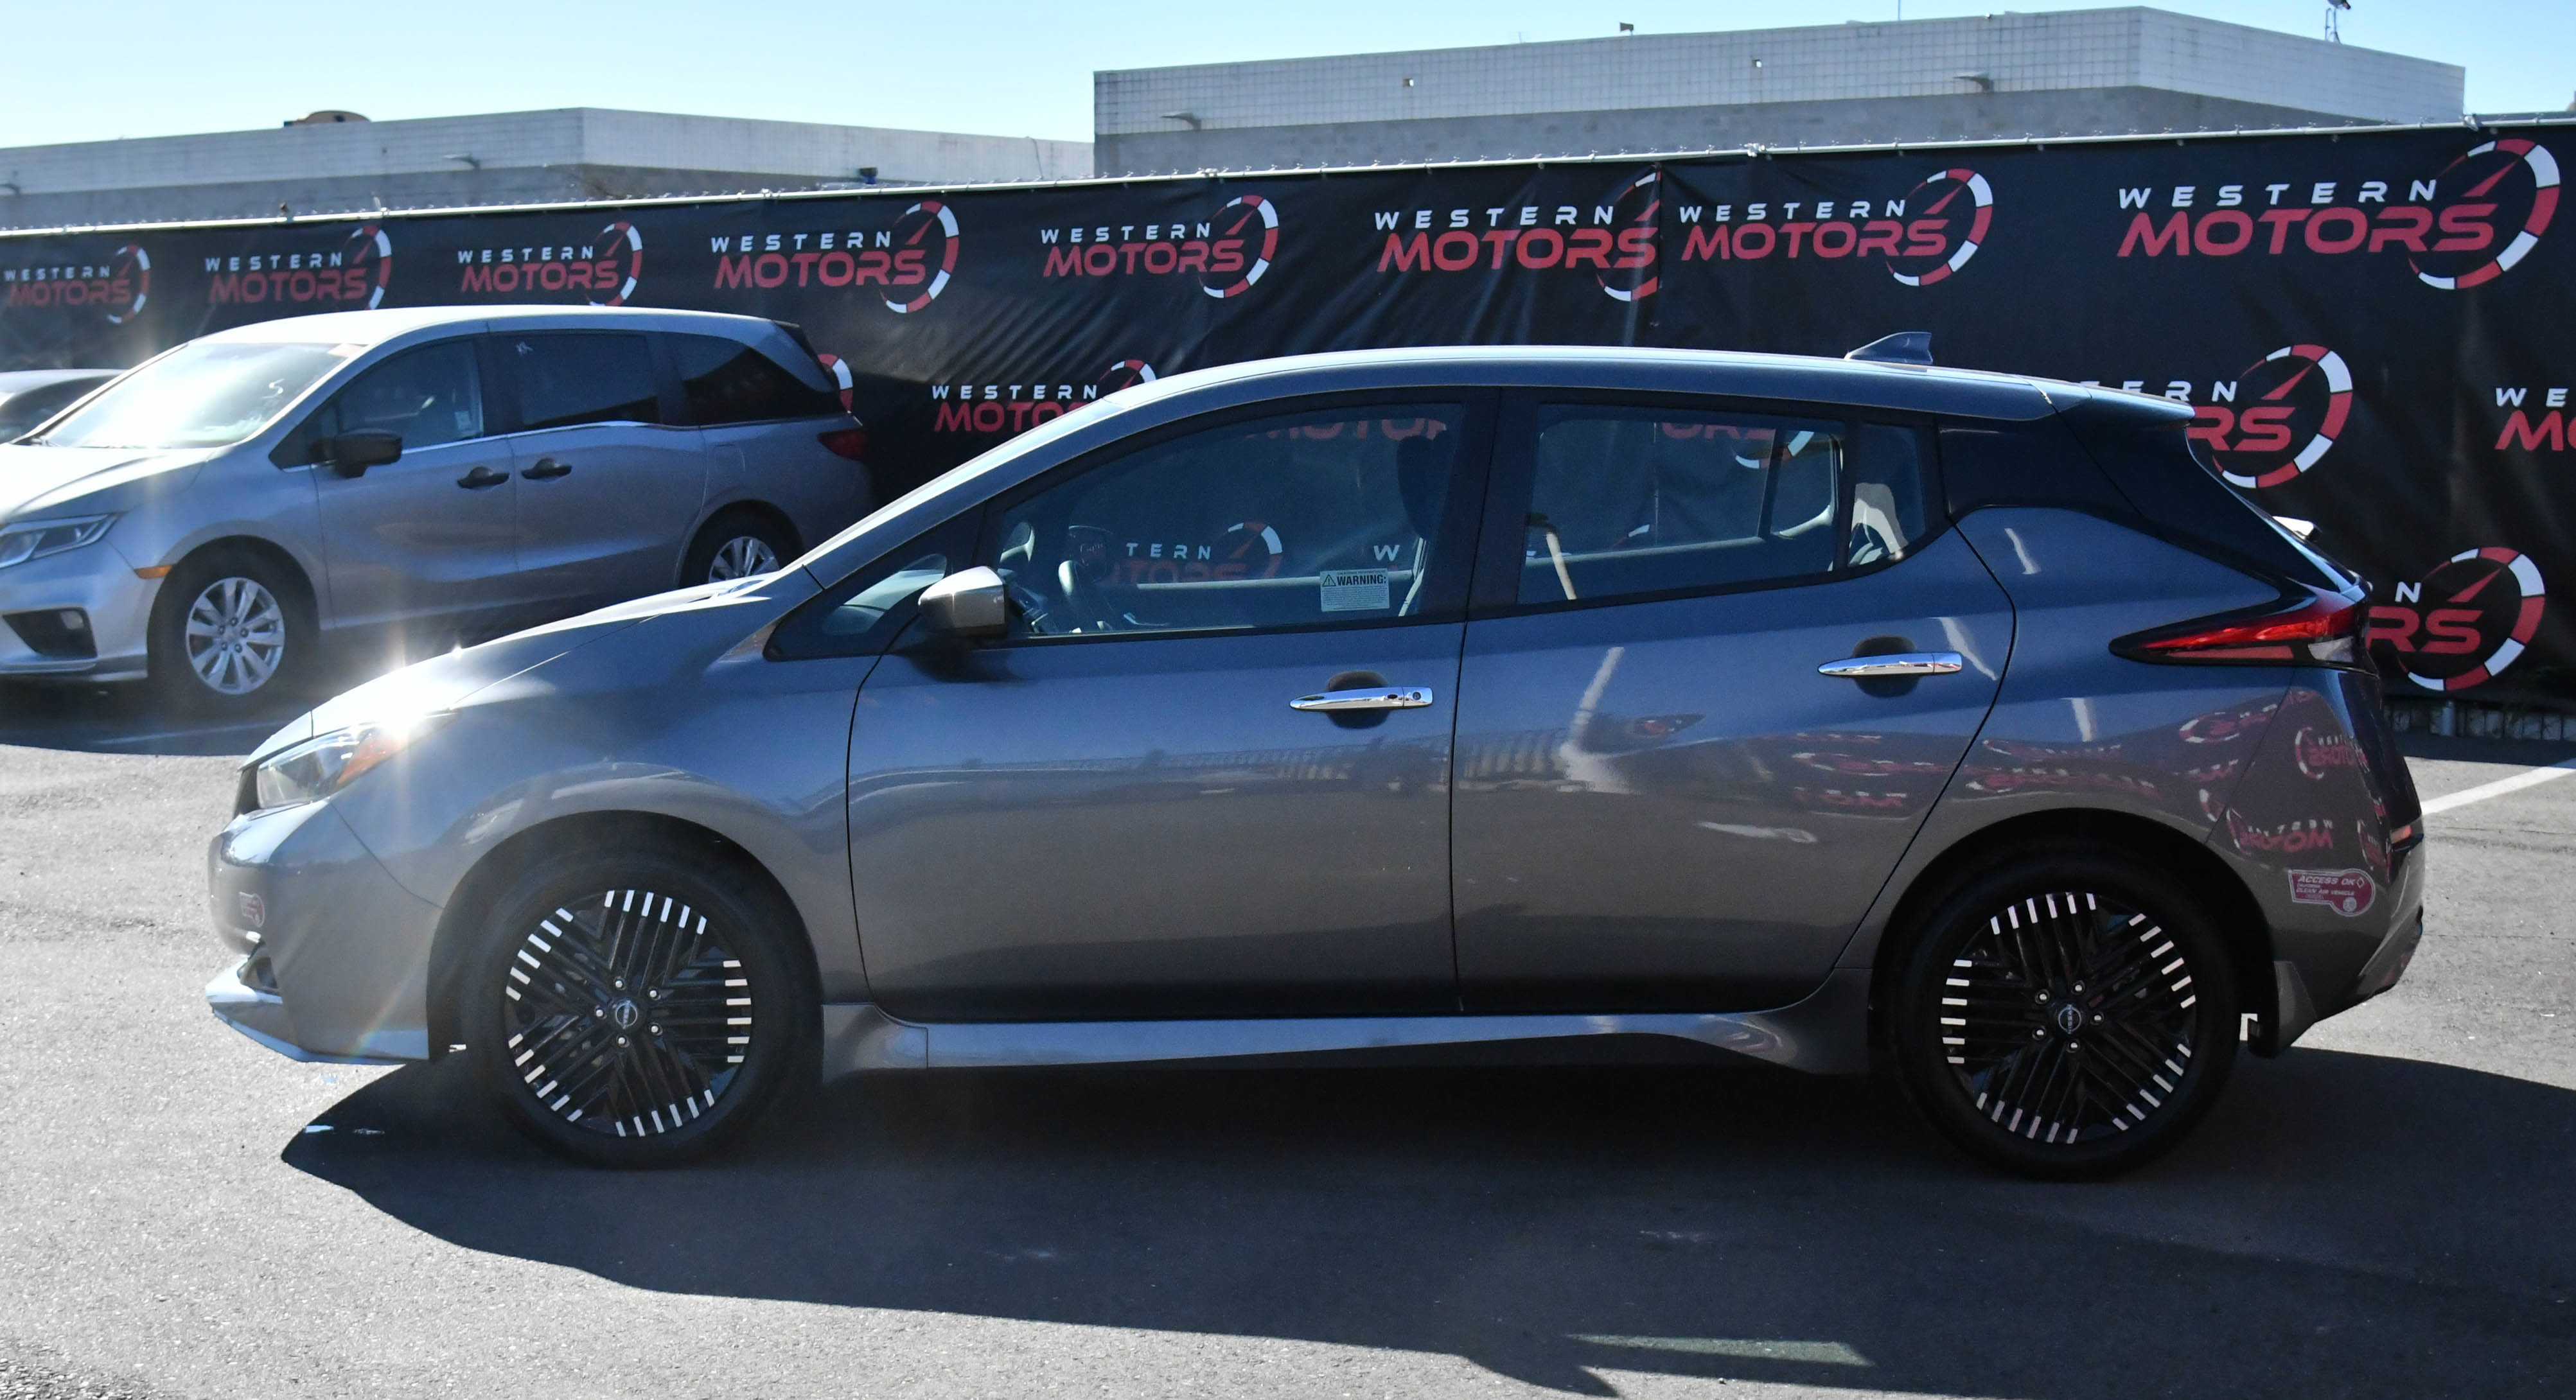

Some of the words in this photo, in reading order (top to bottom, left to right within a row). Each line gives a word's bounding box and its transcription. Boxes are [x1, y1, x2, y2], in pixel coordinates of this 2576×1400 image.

[2119, 179, 2437, 209] WESTERN
[1375, 206, 1614, 230] WESTERN
[1679, 200, 1905, 223] WESTERN
[711, 231, 890, 253] WESTERN
[1041, 222, 1210, 243] WESTERN
[1681, 219, 1949, 261] MOTORS
[2117, 204, 2498, 258] MOTORS
[458, 245, 593, 263] WESTERN
[1043, 239, 1245, 277] MOTORS
[1377, 227, 1658, 272] MOTORS
[4, 265, 110, 282] WESTERN
[205, 252, 342, 272] WESTERN
[714, 250, 926, 288] MOTORS
[209, 267, 367, 304] MOTORS
[461, 259, 619, 292] MOTORS
[9, 279, 131, 307] MOTORS
[932, 384, 1097, 400] WESTERN
[934, 401, 1087, 432] MOTO
[1125, 543, 1211, 561] TERN
[1336, 574, 1386, 586] WARNING:
[2298, 875, 2338, 884] ACCESS
